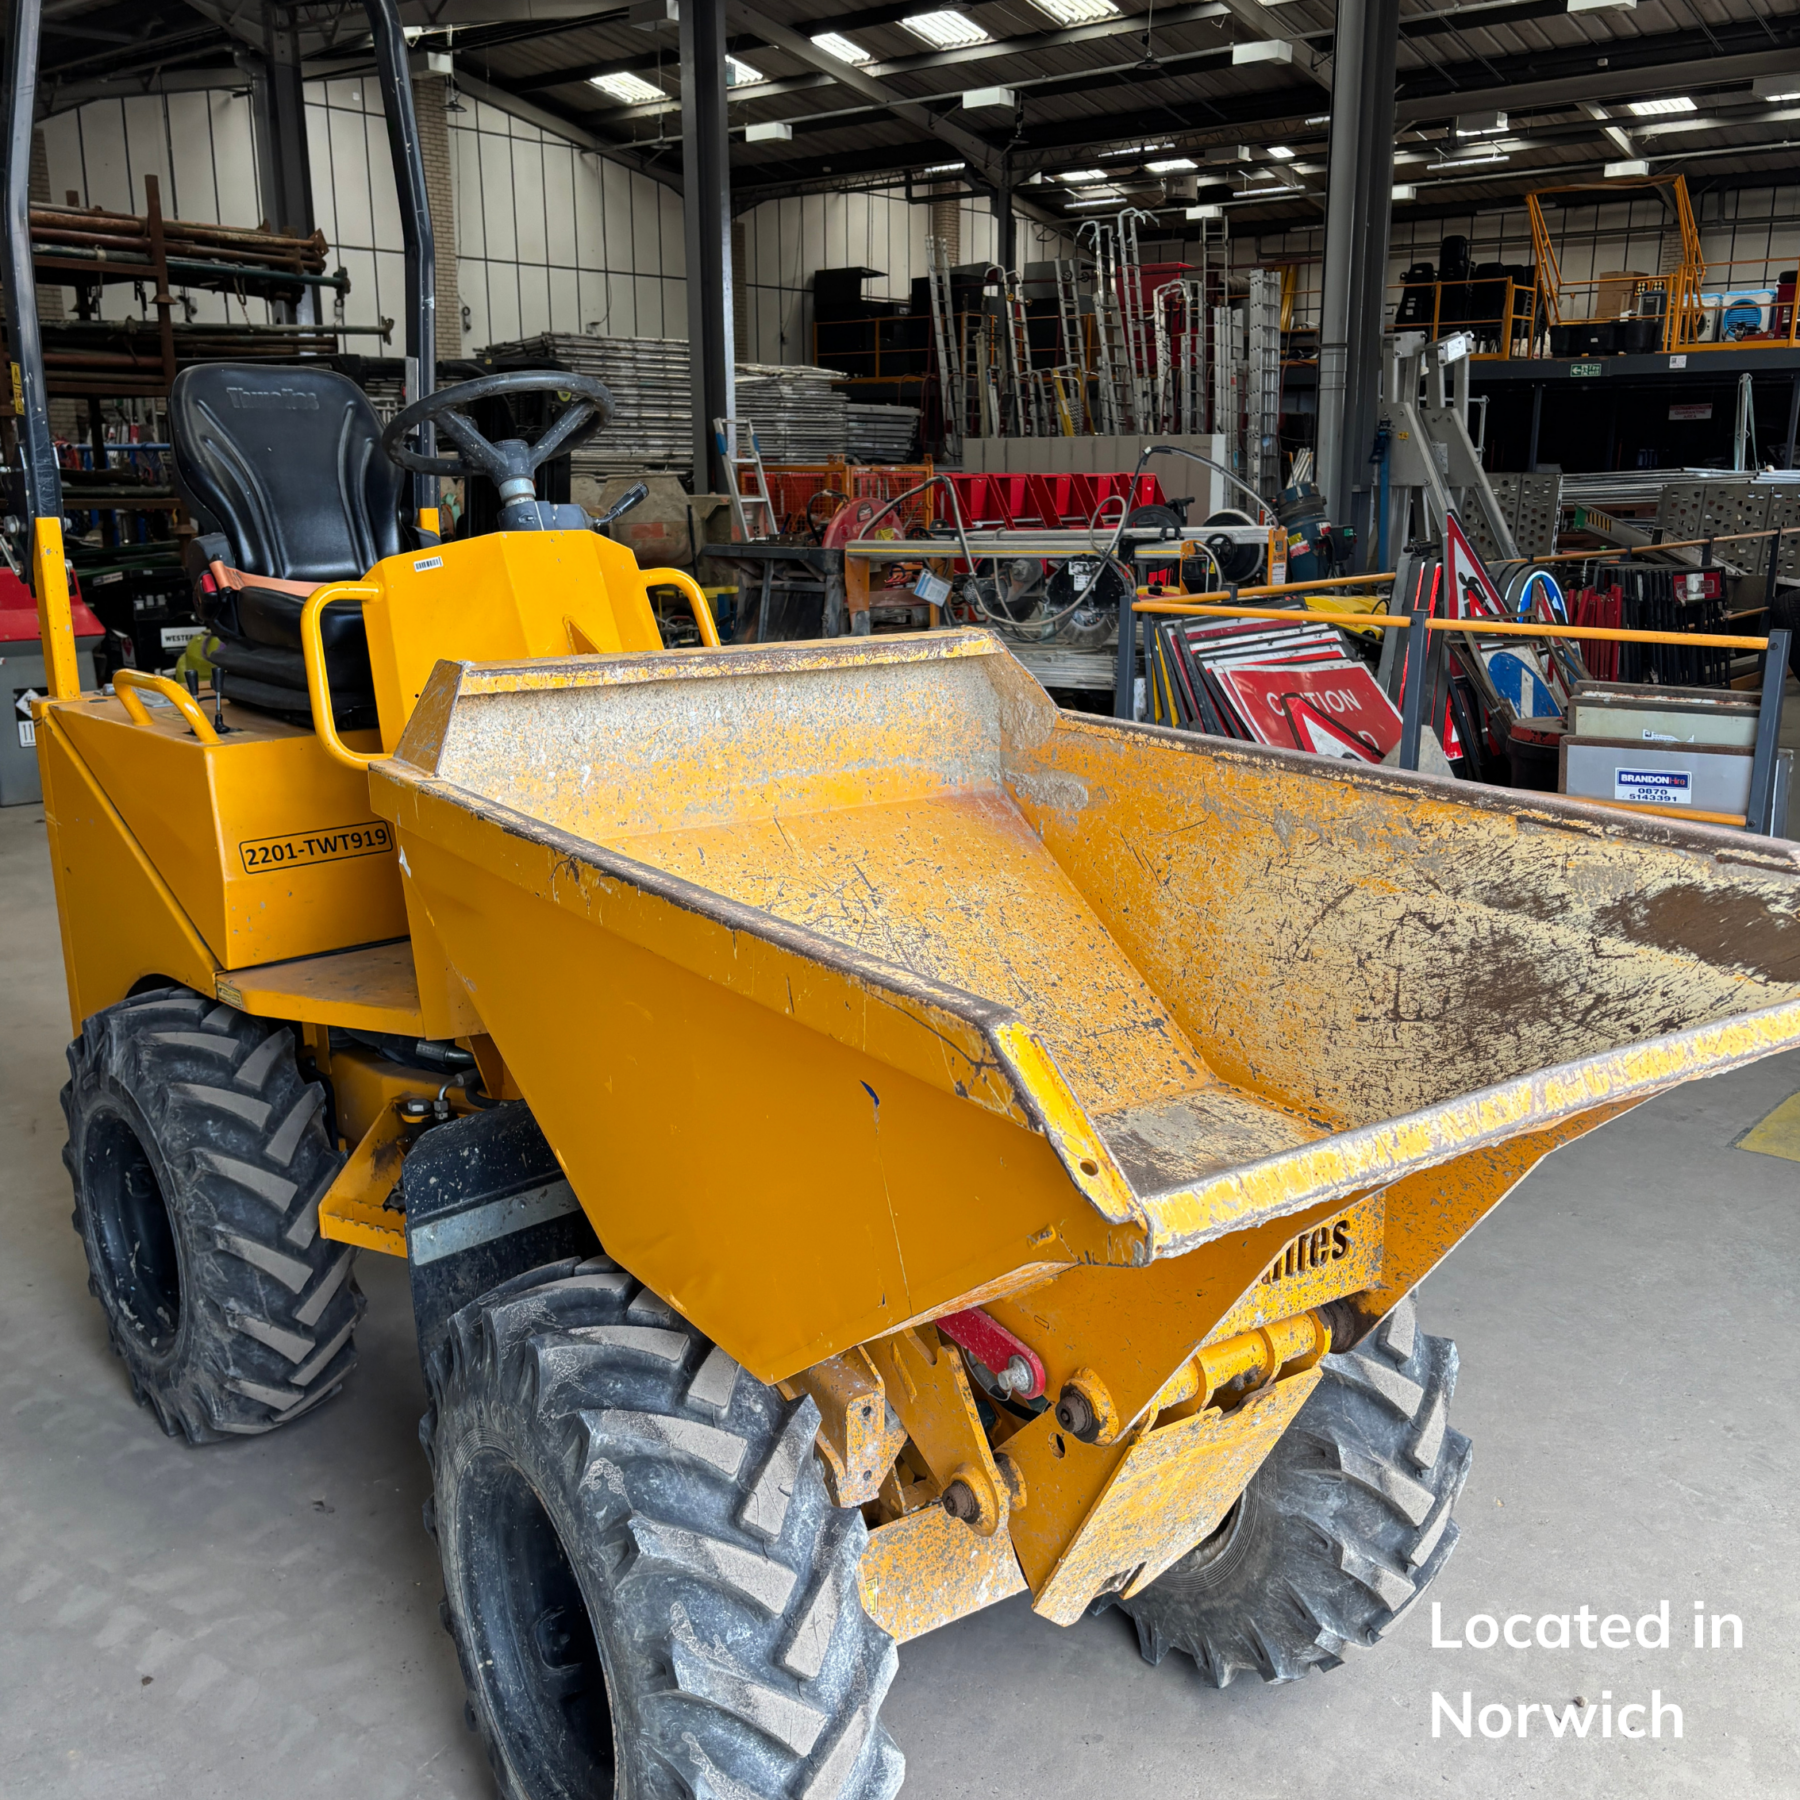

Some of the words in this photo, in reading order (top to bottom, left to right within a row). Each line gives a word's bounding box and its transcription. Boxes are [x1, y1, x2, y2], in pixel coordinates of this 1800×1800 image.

[1266, 689, 1362, 717] CTION
[1629, 793, 1677, 802] 5143391
[245, 828, 387, 866] 2201-TWT919
